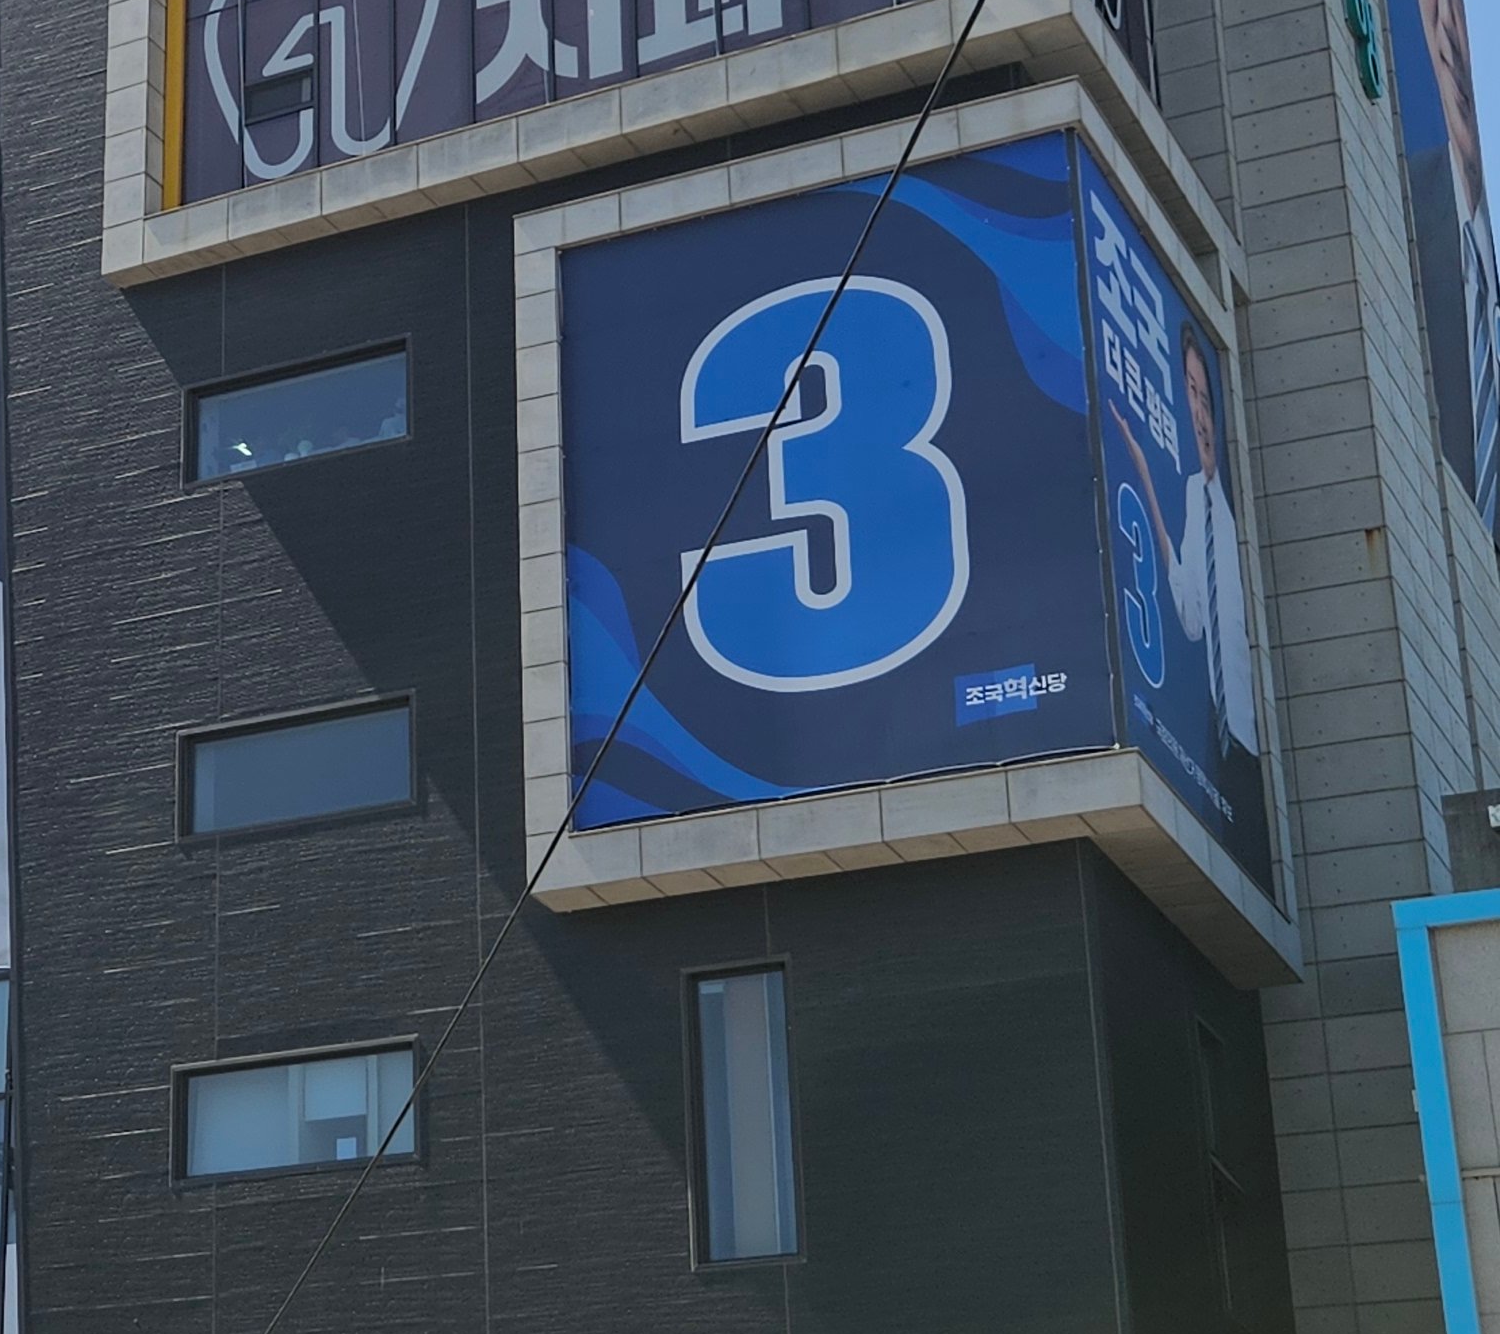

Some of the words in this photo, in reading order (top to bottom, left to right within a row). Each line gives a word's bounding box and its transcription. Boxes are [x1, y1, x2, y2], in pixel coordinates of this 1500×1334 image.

[1089, 189, 1174, 407] 조국
[1101, 318, 1126, 395] 더
[1123, 347, 1147, 424] 큰
[1143, 376, 1182, 476] 평택
[679, 274, 971, 694] 3
[1116, 481, 1166, 690] 3
[964, 672, 1068, 708] 조국혁신당
